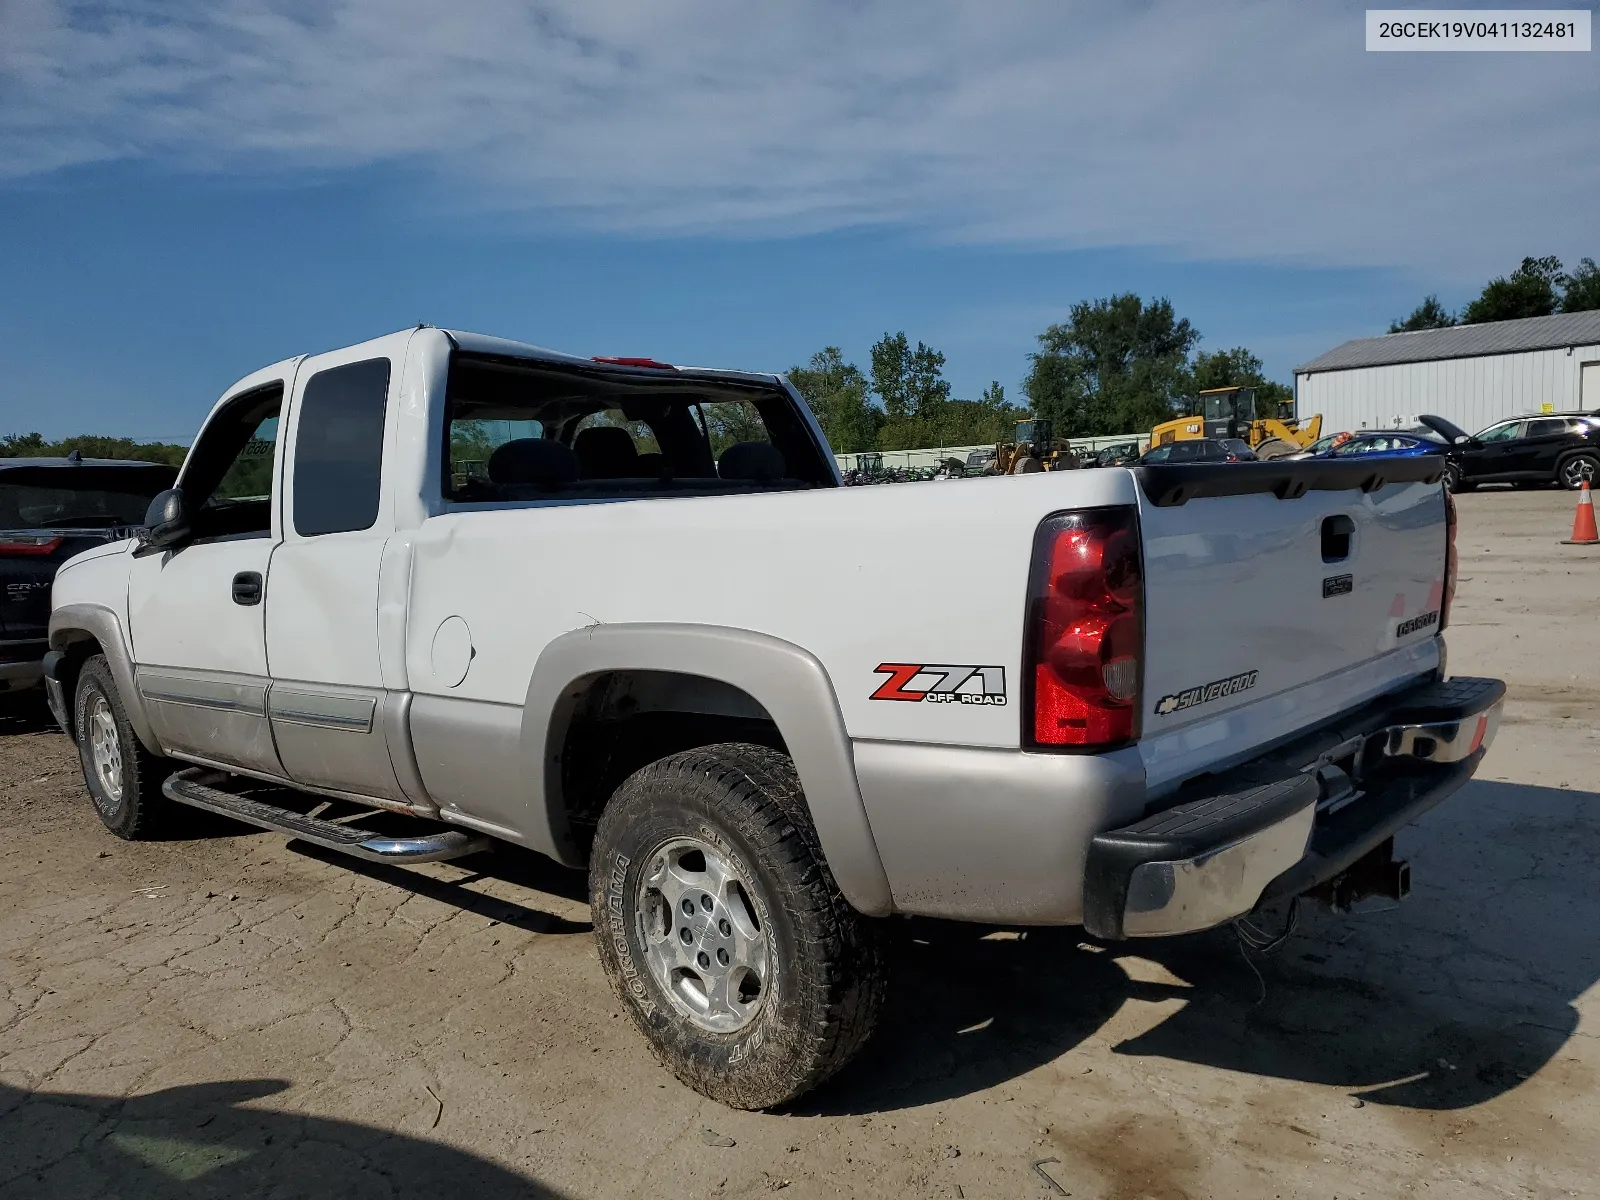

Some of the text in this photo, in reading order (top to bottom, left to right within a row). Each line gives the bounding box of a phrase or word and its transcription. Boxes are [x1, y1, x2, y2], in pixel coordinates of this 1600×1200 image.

[1186, 424, 1199, 433] CAT
[869, 663, 1007, 702] Z71
[926, 692, 1007, 706] OFF ROAD
[1177, 671, 1259, 710] SILVERADO
[609, 853, 657, 1019] YOKOHAMA
